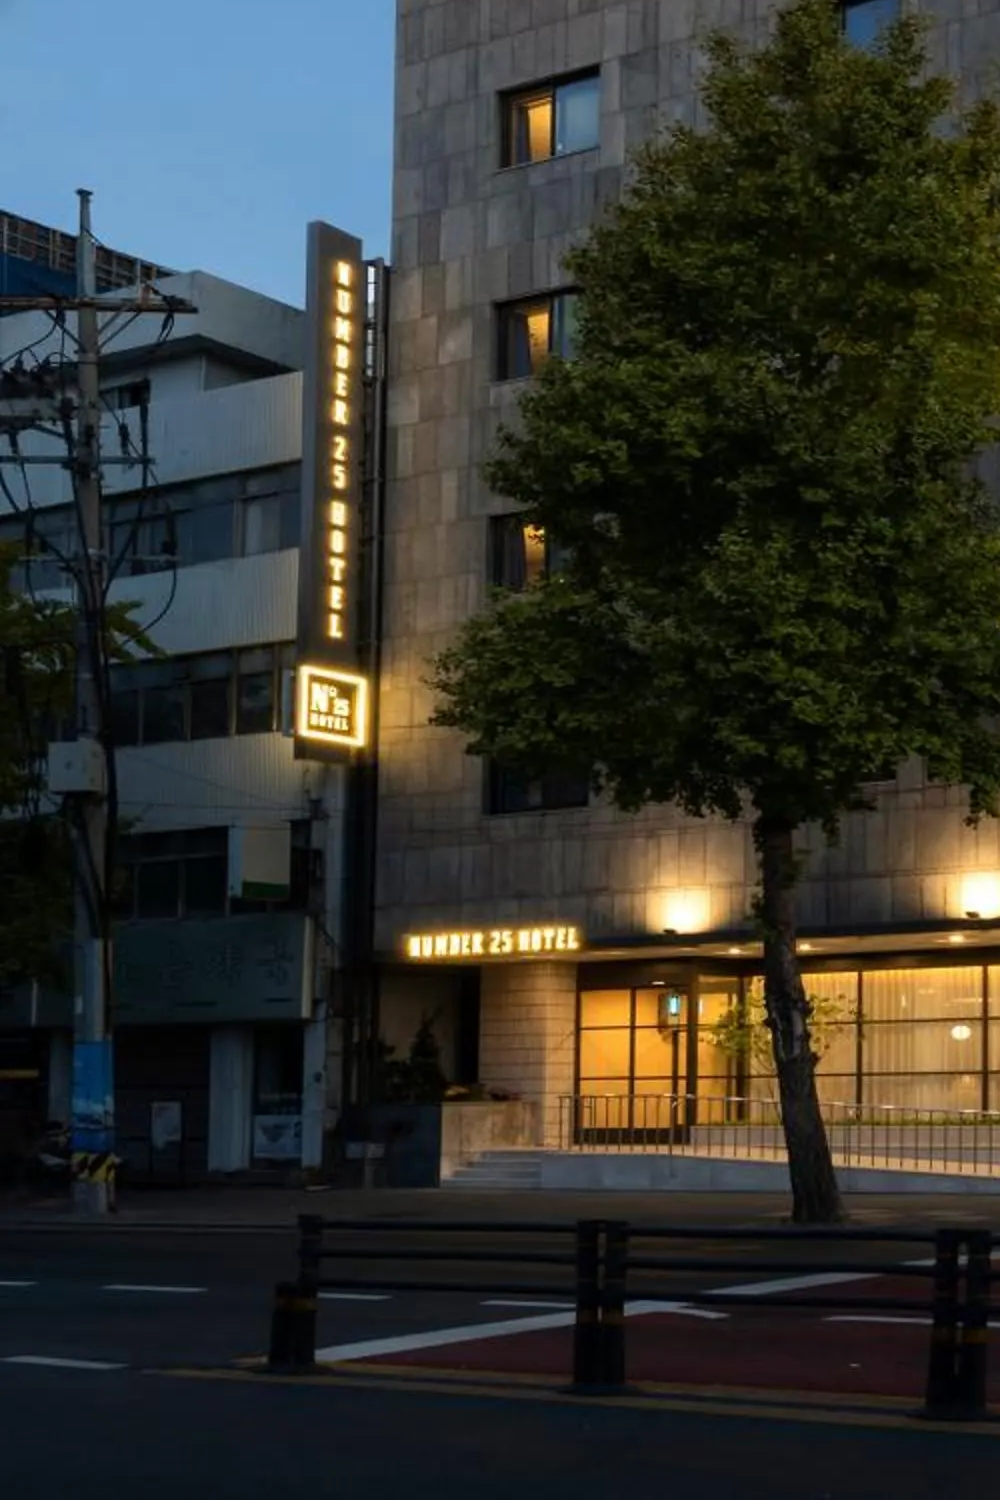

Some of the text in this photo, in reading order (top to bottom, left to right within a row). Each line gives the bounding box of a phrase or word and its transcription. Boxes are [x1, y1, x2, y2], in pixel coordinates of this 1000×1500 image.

[328, 260, 353, 639] NUMBER 25 HOTEL
[310, 712, 349, 731] HOTEL
[409, 927, 579, 957] NUMBER 25 HOTEL
